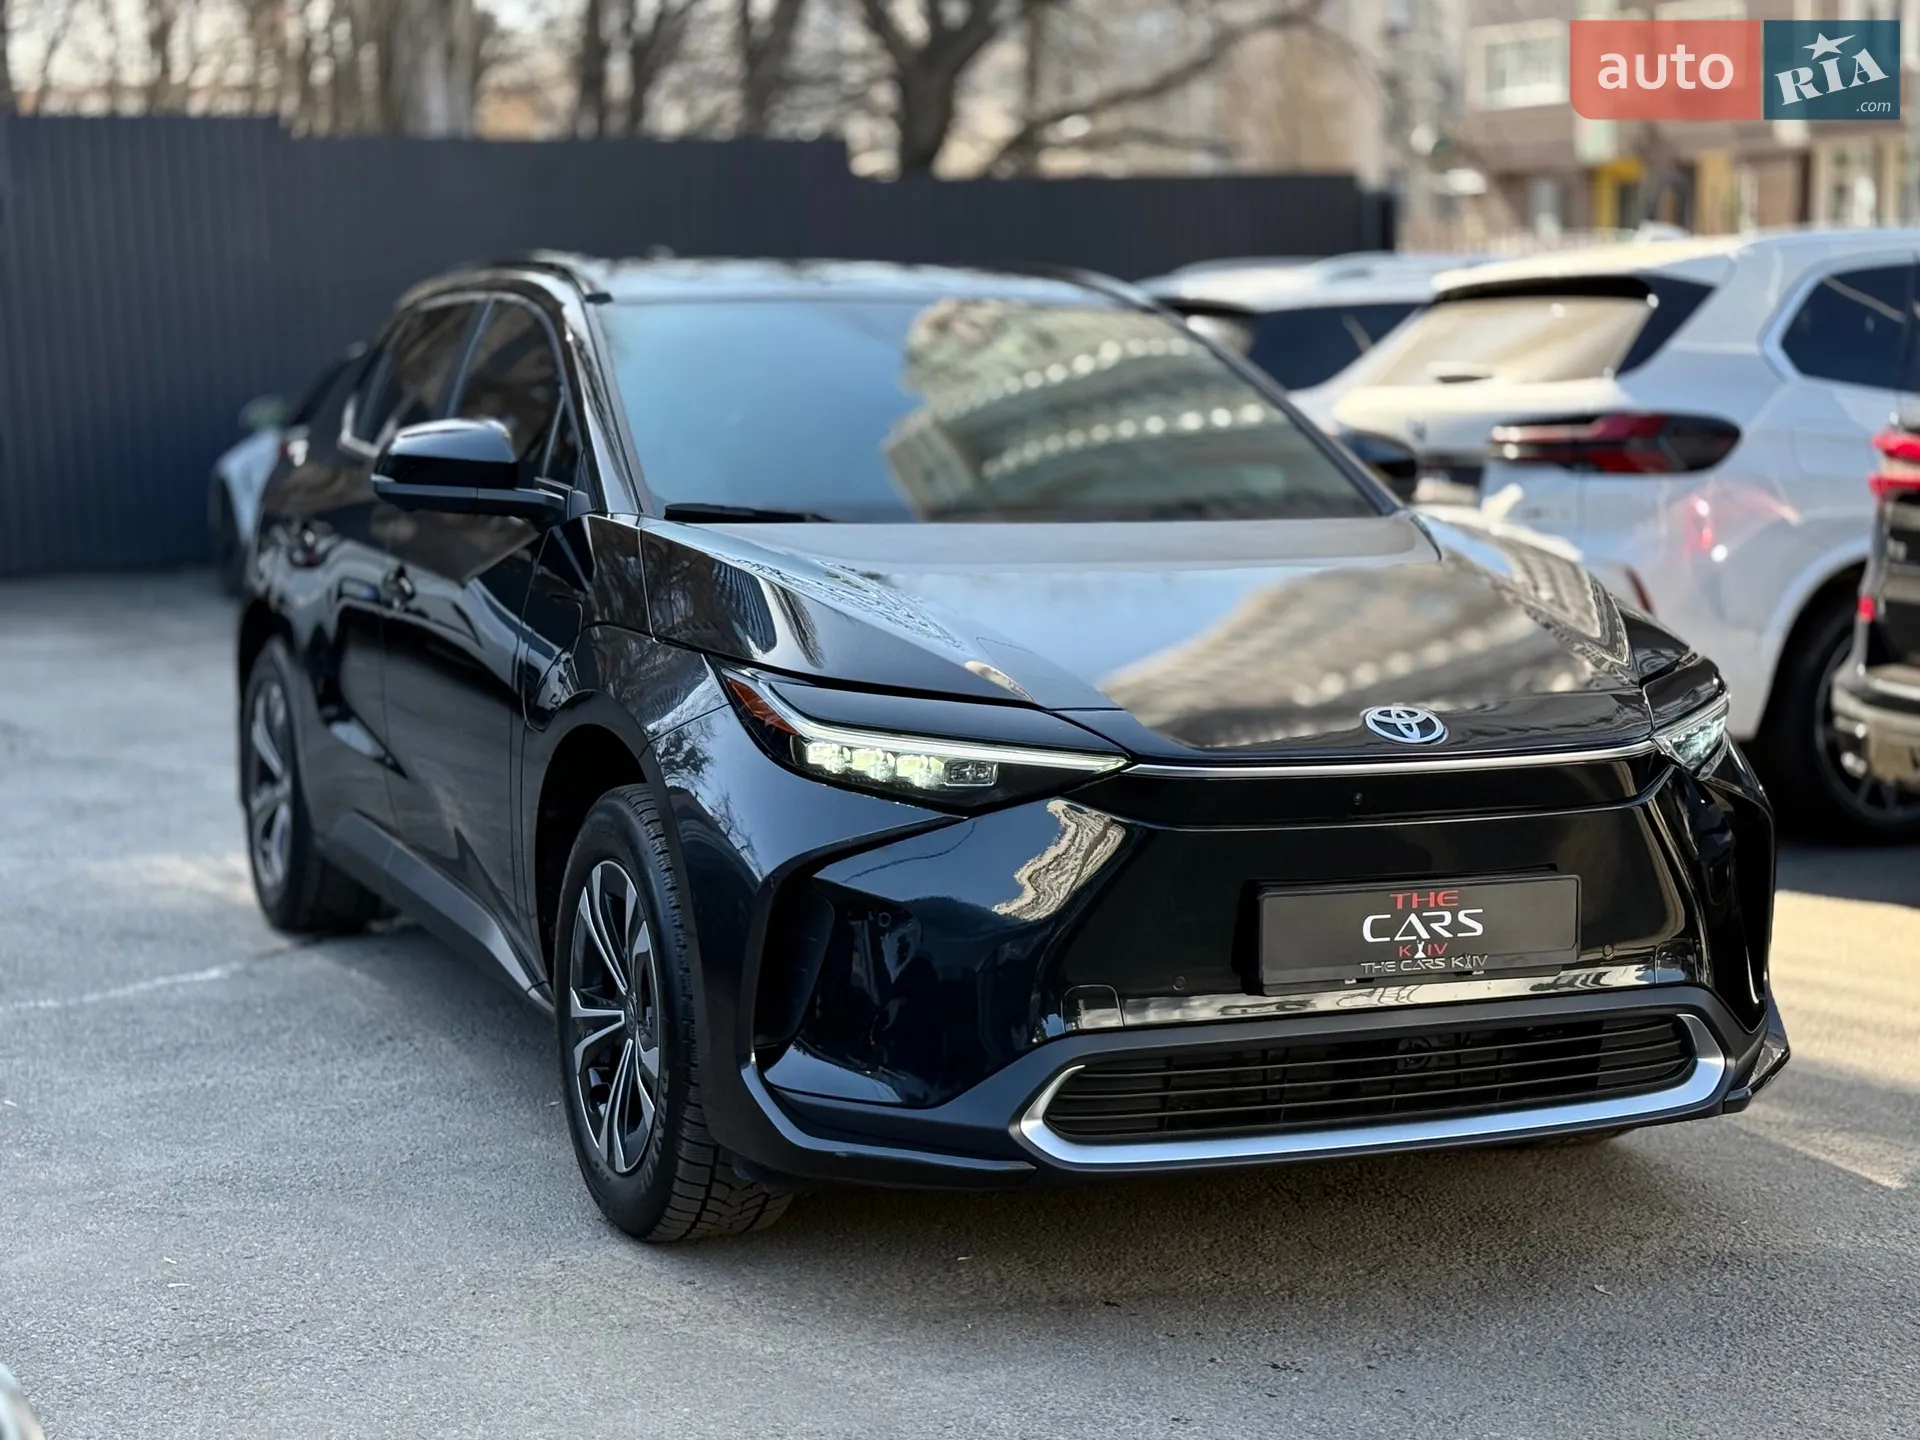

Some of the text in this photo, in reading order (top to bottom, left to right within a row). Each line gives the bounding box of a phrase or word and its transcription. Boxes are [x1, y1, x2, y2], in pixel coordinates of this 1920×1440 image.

[1390, 890, 1459, 909] THE
[1362, 908, 1483, 942] CARS
[1360, 961, 1396, 974] THE
[1400, 958, 1446, 971] CARS
